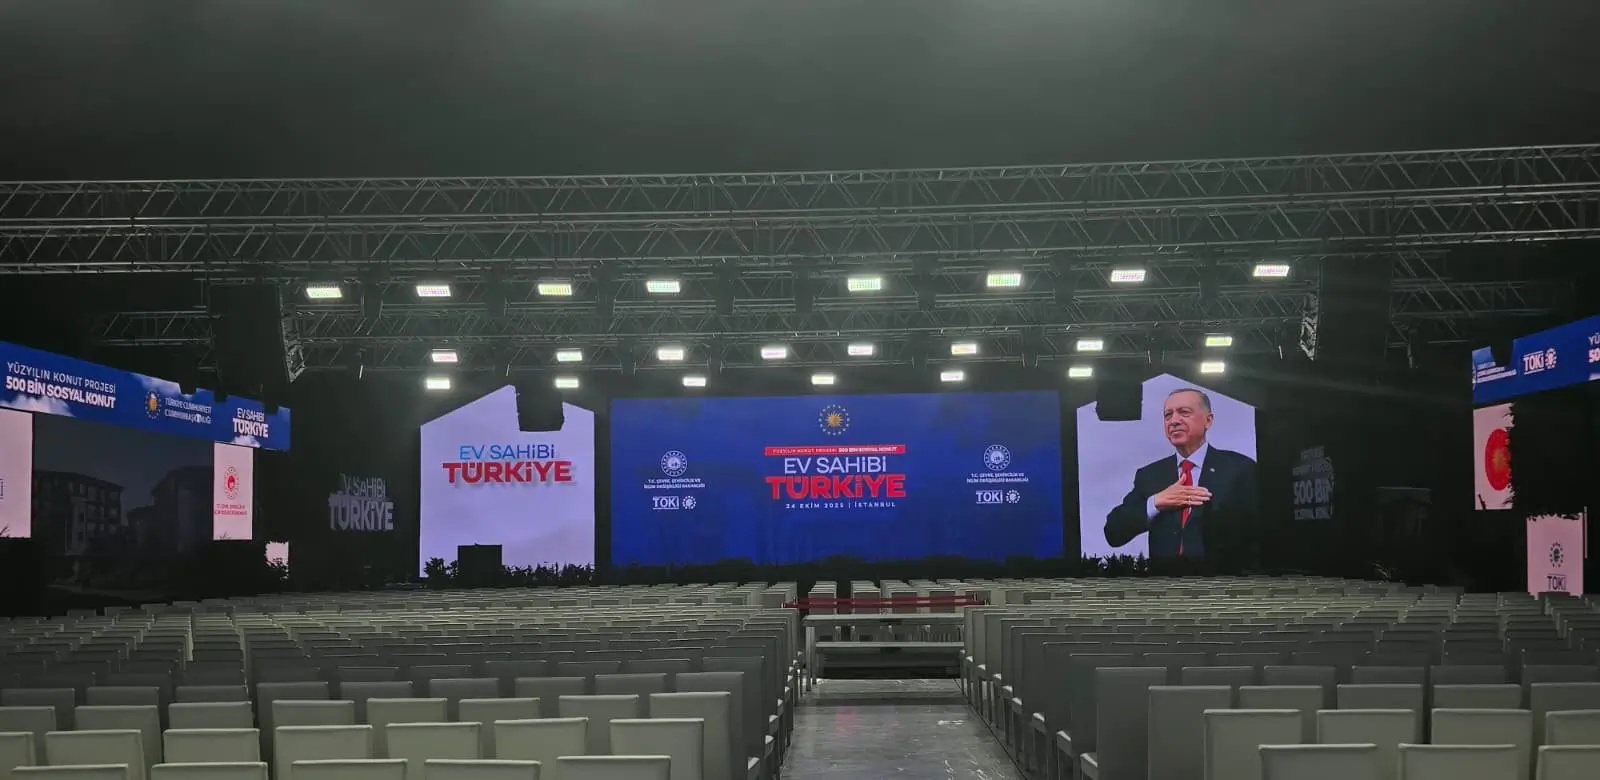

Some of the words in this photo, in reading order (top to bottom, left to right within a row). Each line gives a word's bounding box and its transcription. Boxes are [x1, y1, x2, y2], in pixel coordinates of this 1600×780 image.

[7, 361, 51, 380] YÜZYILIN
[53, 371, 82, 387] KONUT
[84, 378, 116, 393] PROJESİ
[6, 375, 26, 390] 500
[27, 378, 46, 395] BİN
[46, 384, 85, 402] SOSYAL
[86, 392, 116, 408] KONUT
[237, 407, 246, 419] EV
[232, 417, 269, 438] TÜRKİYE
[460, 445, 485, 460] EV
[490, 444, 555, 460] SAHİBİ
[442, 461, 573, 484] TÜRKİYE
[784, 457, 811, 474] EV
[816, 455, 887, 474] SAHİBİ
[765, 475, 906, 500] TÜRKİYE
[328, 491, 394, 530] TÜRKİYE
